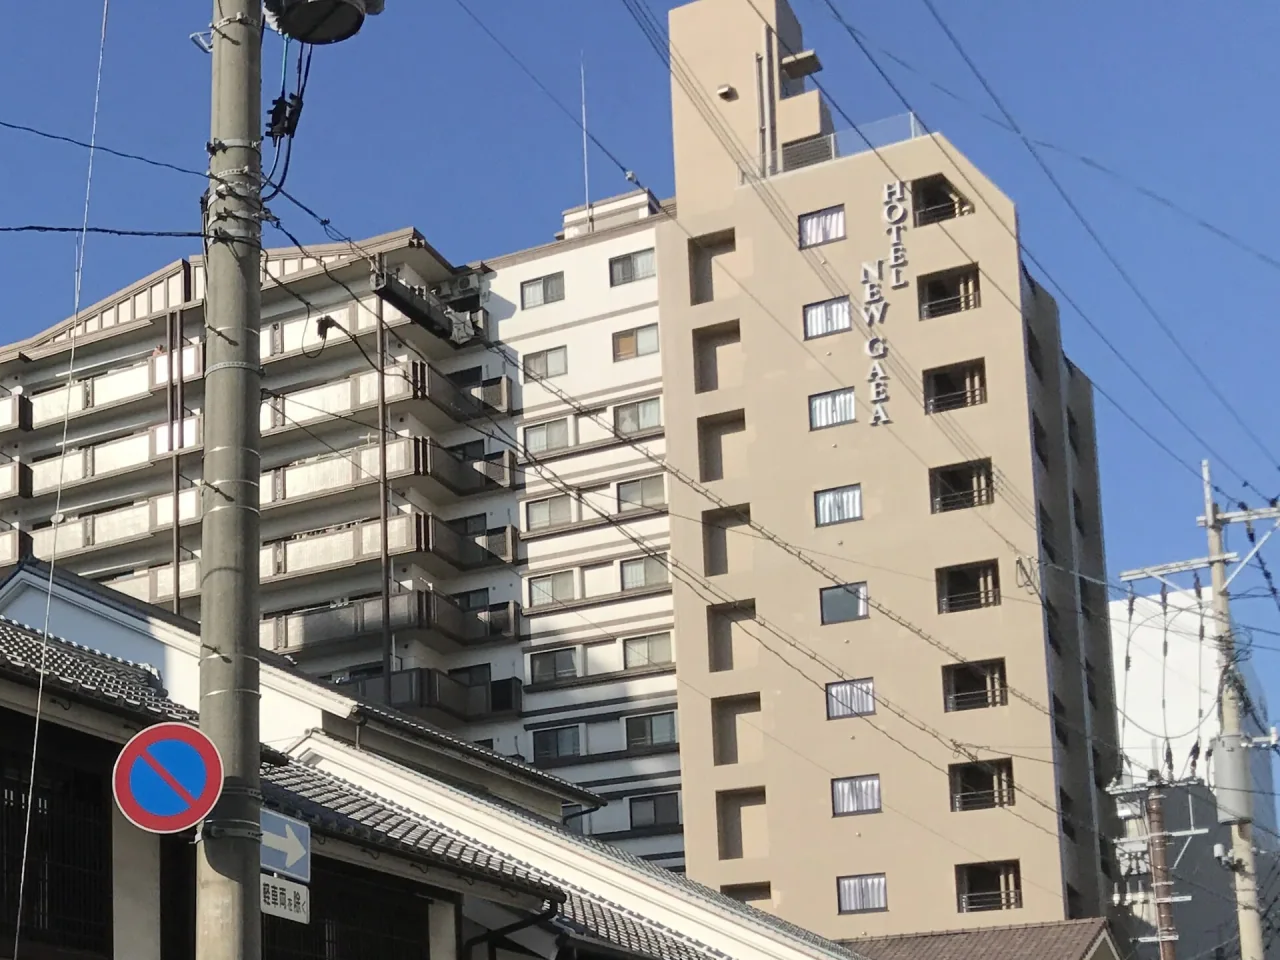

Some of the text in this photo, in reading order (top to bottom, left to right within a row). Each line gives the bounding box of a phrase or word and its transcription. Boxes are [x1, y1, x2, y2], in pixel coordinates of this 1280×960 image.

[883, 180, 910, 290] HOTEL
[860, 259, 893, 426] NEW GAEA
